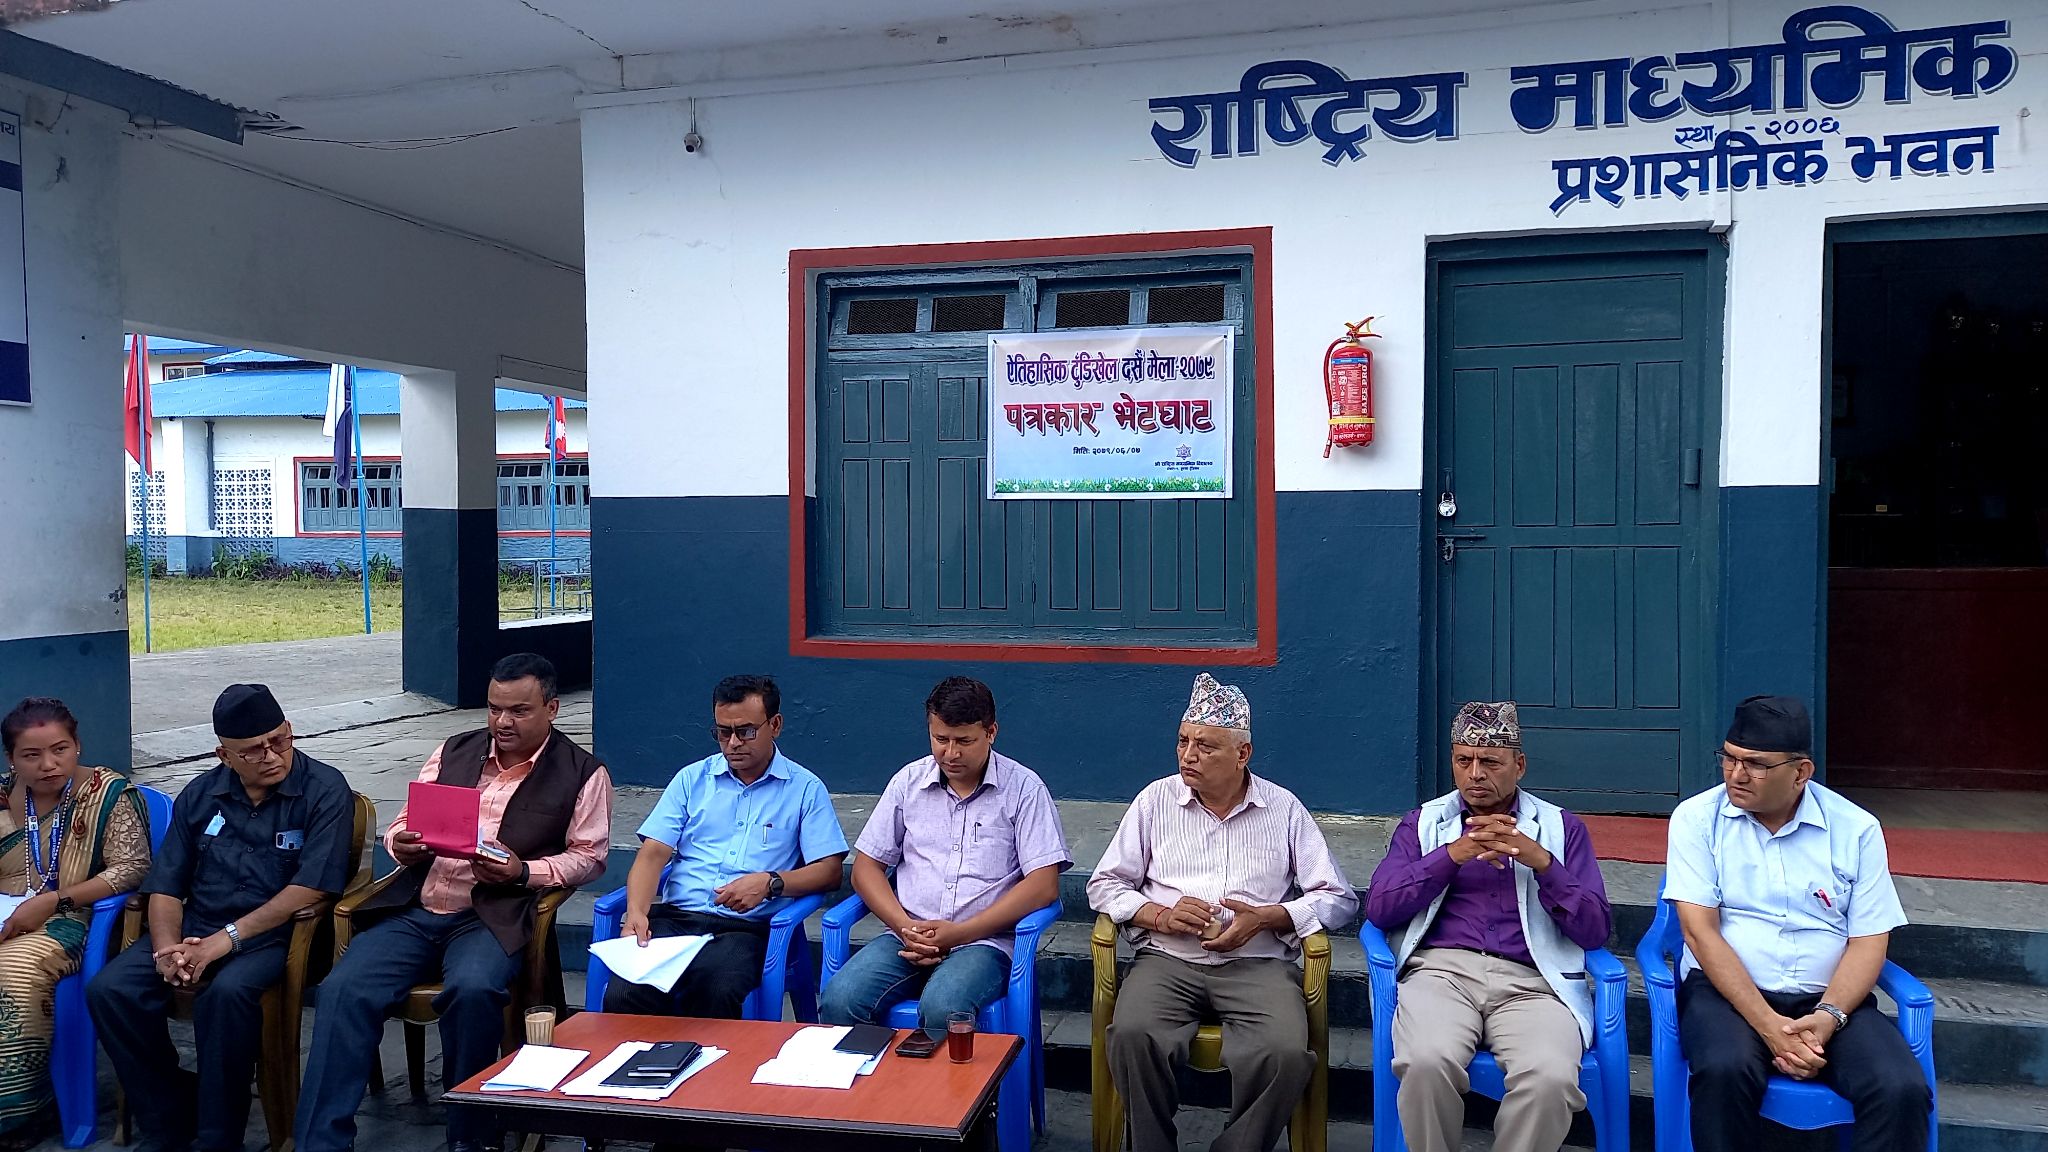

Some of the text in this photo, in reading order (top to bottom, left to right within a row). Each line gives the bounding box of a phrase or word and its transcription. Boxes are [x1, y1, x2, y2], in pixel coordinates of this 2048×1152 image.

[1149, 5, 2017, 167] राष्ट्रिय माध्यमिक
[1765, 117, 1841, 141] २००६
[1549, 126, 2000, 215] प्रशासनिक भवन
[1006, 352, 1068, 385] ऐतिहासिक
[1003, 393, 1214, 435] पत्रकार भेटघाट
